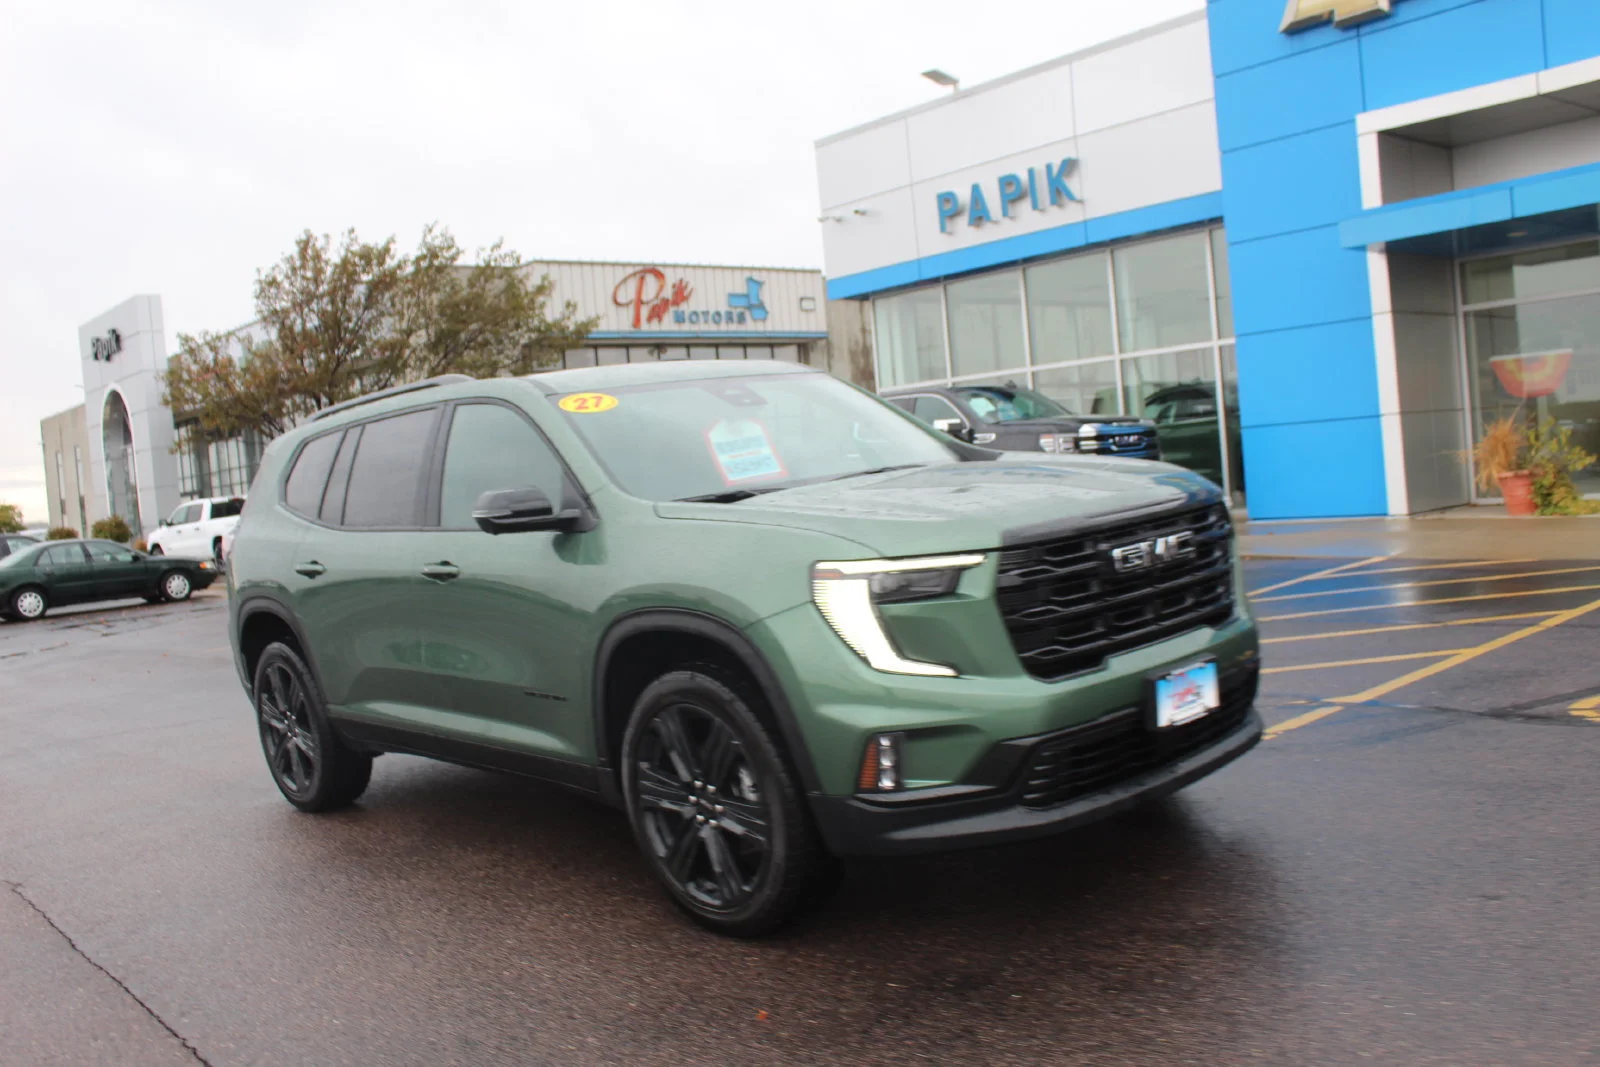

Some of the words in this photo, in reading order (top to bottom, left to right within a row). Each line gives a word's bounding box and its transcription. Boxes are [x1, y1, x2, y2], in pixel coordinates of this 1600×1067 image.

[936, 157, 1081, 234] PAPIK
[672, 309, 747, 325] MOTORS
[573, 396, 603, 410] 27
[1111, 531, 1196, 572] GMC
